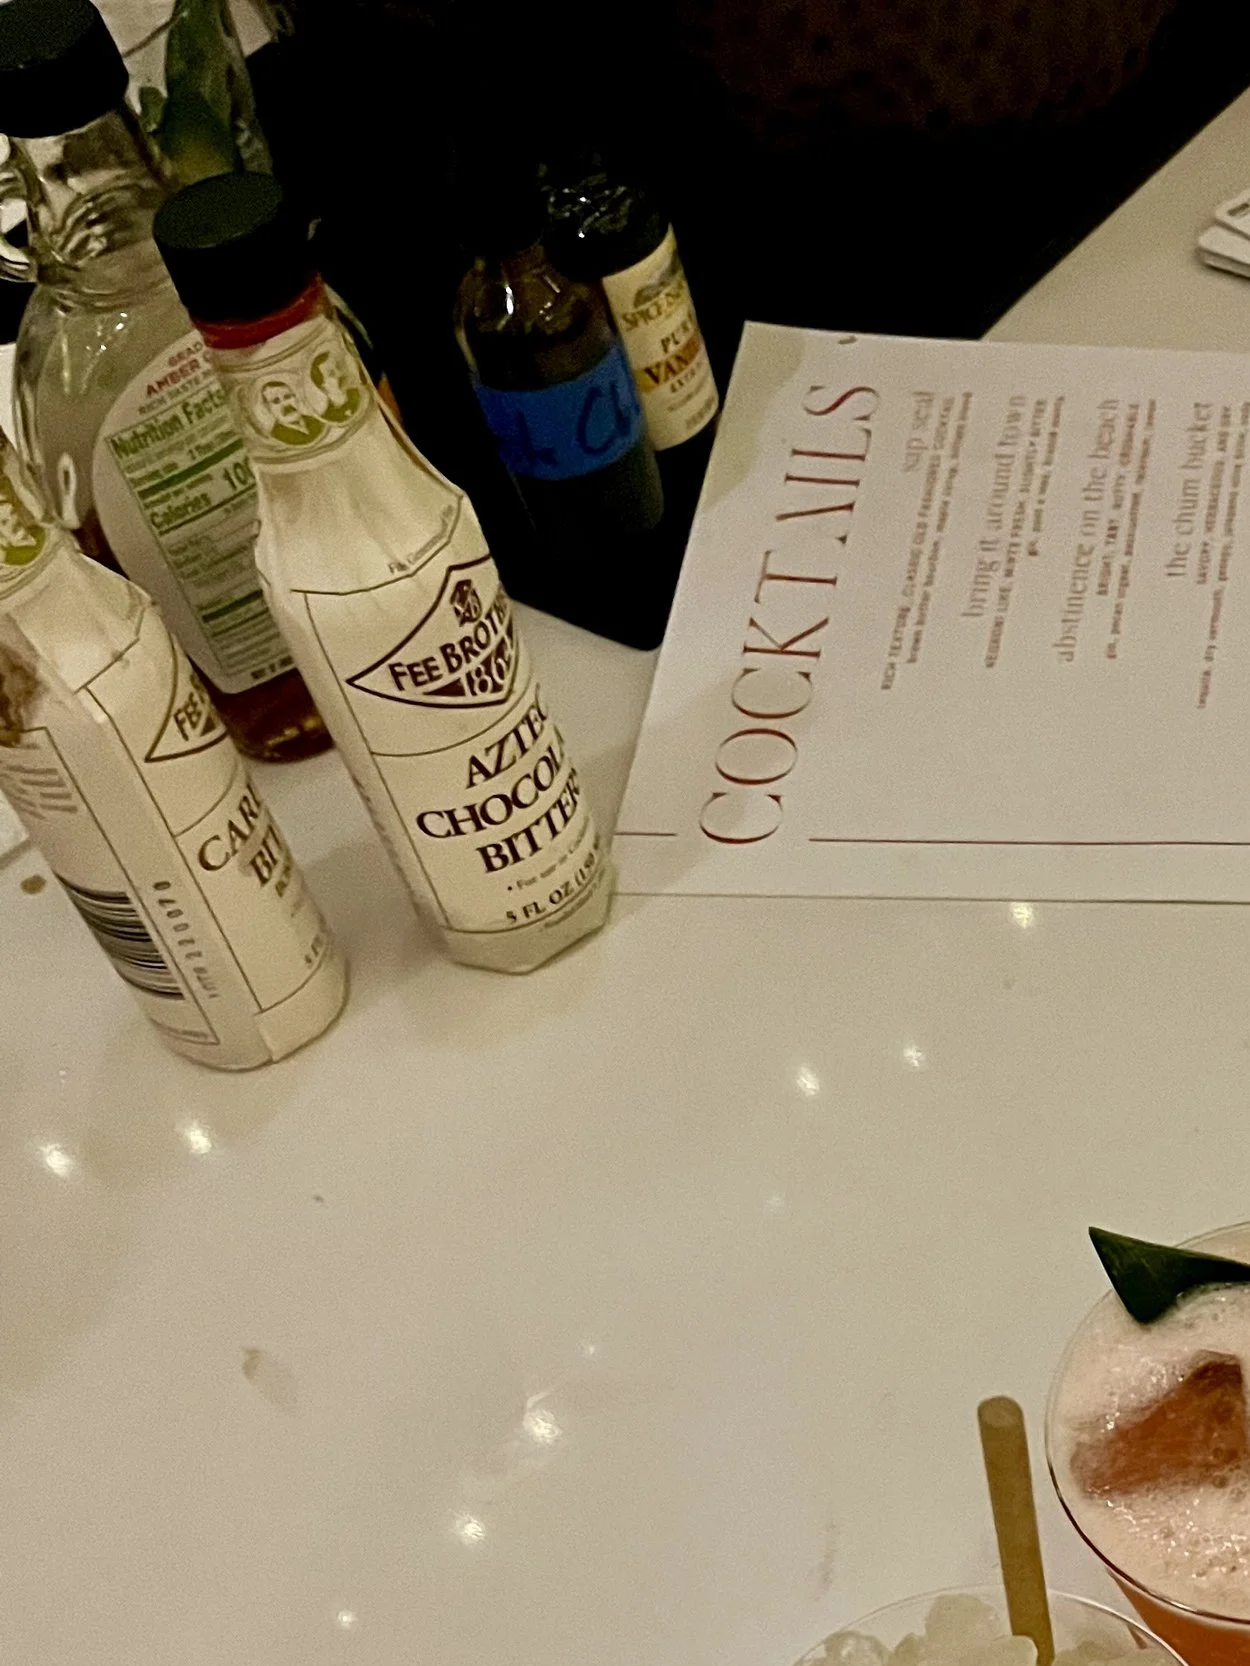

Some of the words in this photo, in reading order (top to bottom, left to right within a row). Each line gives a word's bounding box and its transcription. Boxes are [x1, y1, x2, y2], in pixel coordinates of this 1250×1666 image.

[146, 357, 200, 396] AMBER
[110, 412, 186, 460] Nutrition
[182, 383, 228, 425] Facts
[996, 394, 1026, 447] town
[1087, 398, 1119, 460] beach
[1180, 401, 1212, 470] bucket
[986, 452, 1015, 531] around
[1081, 466, 1108, 502] the
[151, 492, 212, 530] Calories
[1079, 509, 1101, 537] on
[1172, 478, 1200, 536] chum
[978, 538, 1000, 553] it
[1164, 542, 1191, 578] the
[960, 557, 1000, 618] bring
[1053, 543, 1095, 662] abstinence
[700, 385, 881, 845] COCKTAILS
[1203, 643, 1217, 663] dry
[389, 656, 443, 692] FEE
[880, 661, 896, 691] RICH
[522, 900, 546, 920] FL
[548, 881, 575, 905] OZ
